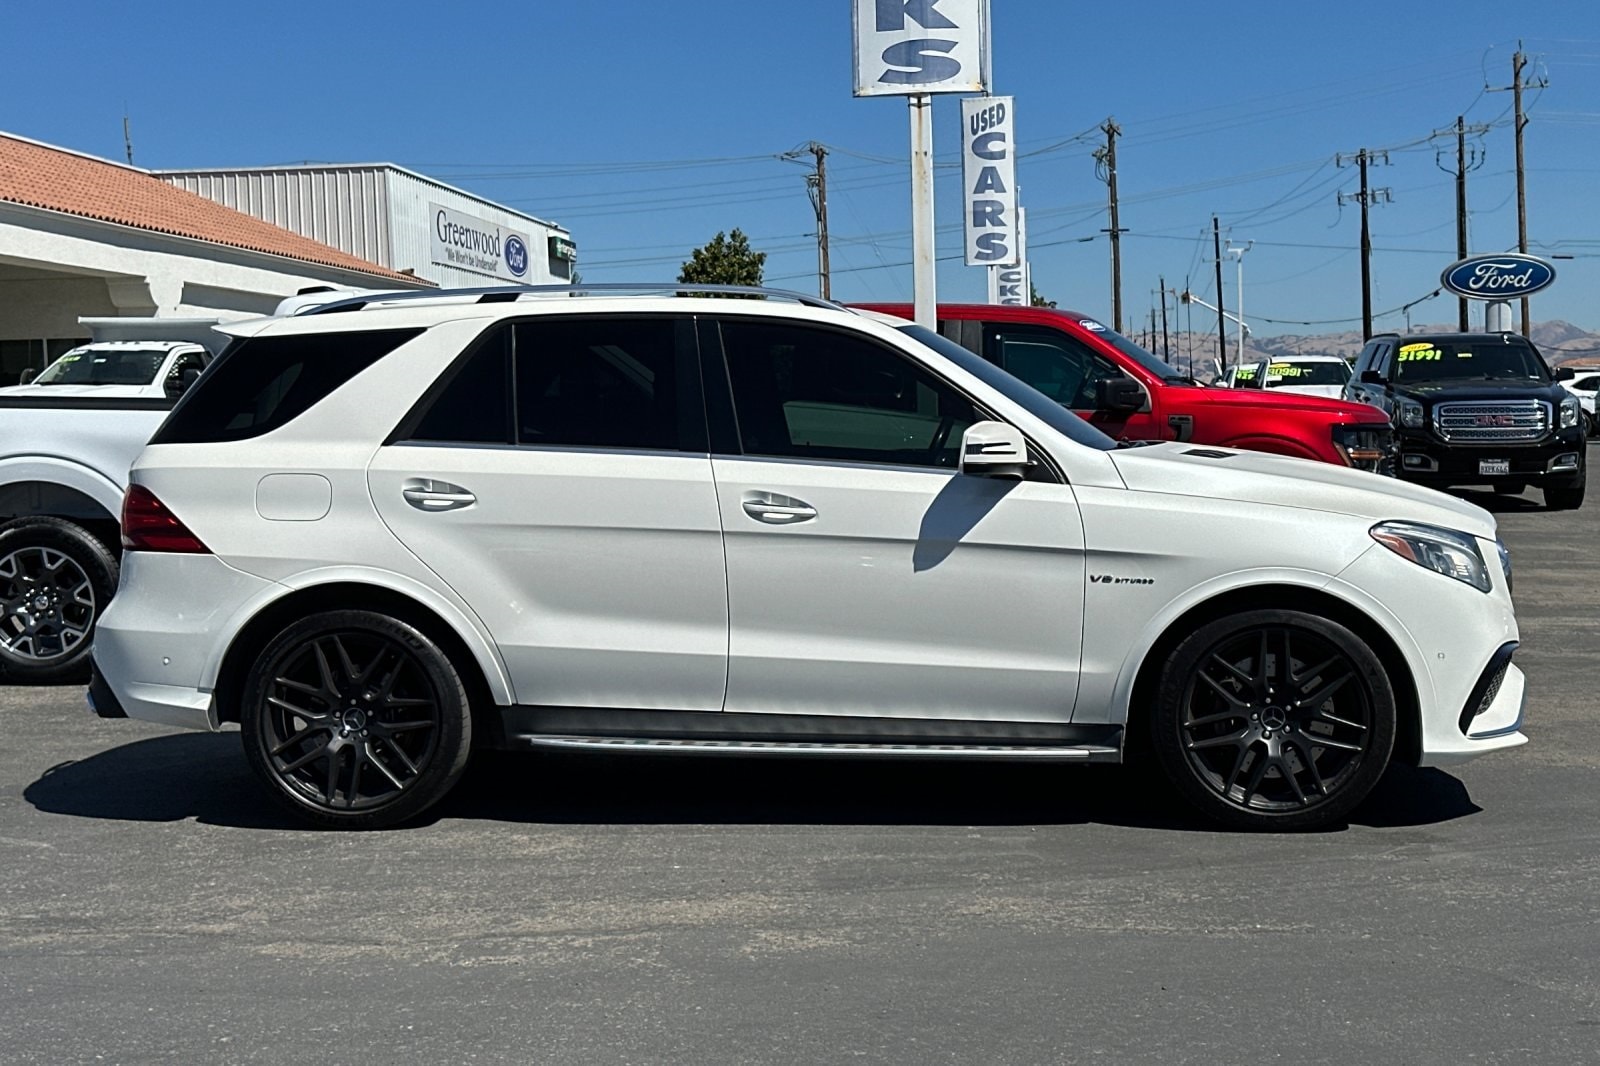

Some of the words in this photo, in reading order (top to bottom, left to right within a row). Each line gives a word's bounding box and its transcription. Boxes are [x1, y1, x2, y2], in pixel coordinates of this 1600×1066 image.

[970, 103, 1005, 136] USED
[971, 131, 1008, 261] CARS
[436, 209, 501, 257] Greenwood
[468, 253, 475, 267] be
[509, 240, 524, 268] Ford
[1469, 263, 1533, 289] Ford
[1398, 349, 1442, 362] 31991
[1475, 415, 1513, 426] GMC
[1090, 575, 1113, 583] V8
